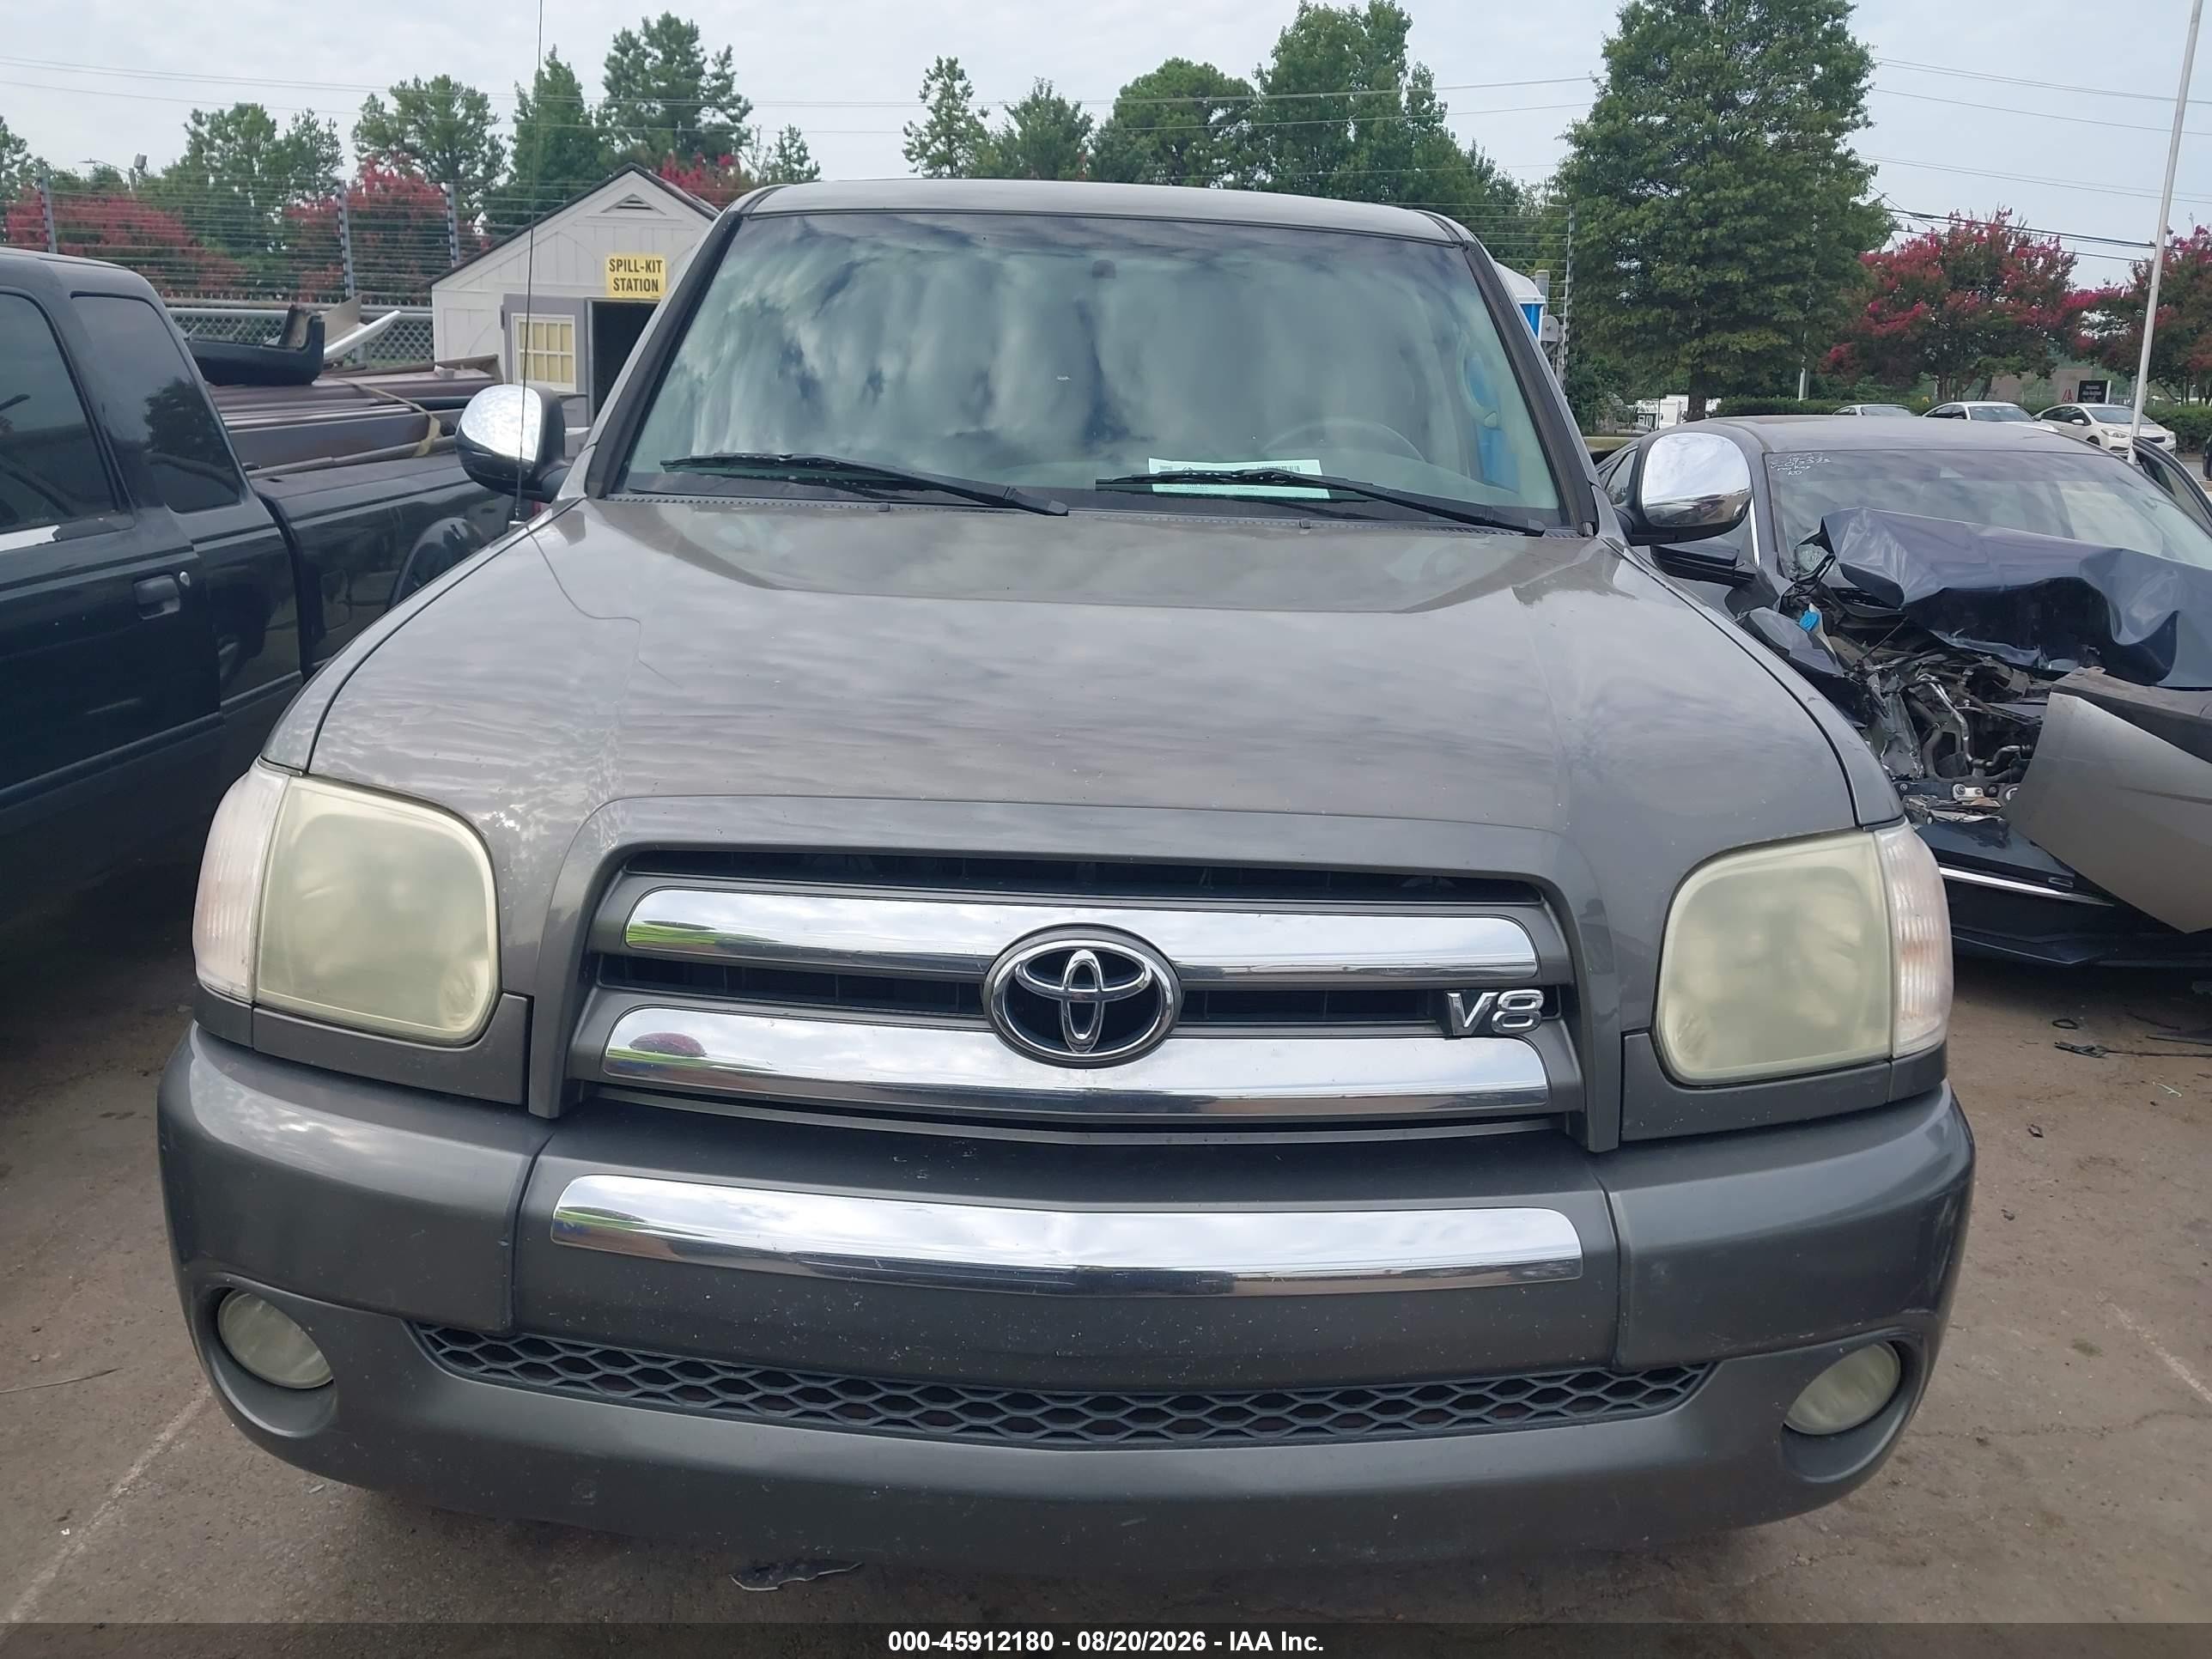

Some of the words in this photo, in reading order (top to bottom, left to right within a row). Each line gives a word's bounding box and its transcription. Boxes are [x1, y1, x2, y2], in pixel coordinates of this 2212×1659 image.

[609, 258, 663, 273] SPILL-KIT
[613, 277, 659, 292] STATION
[1446, 989, 1544, 1036] V8
